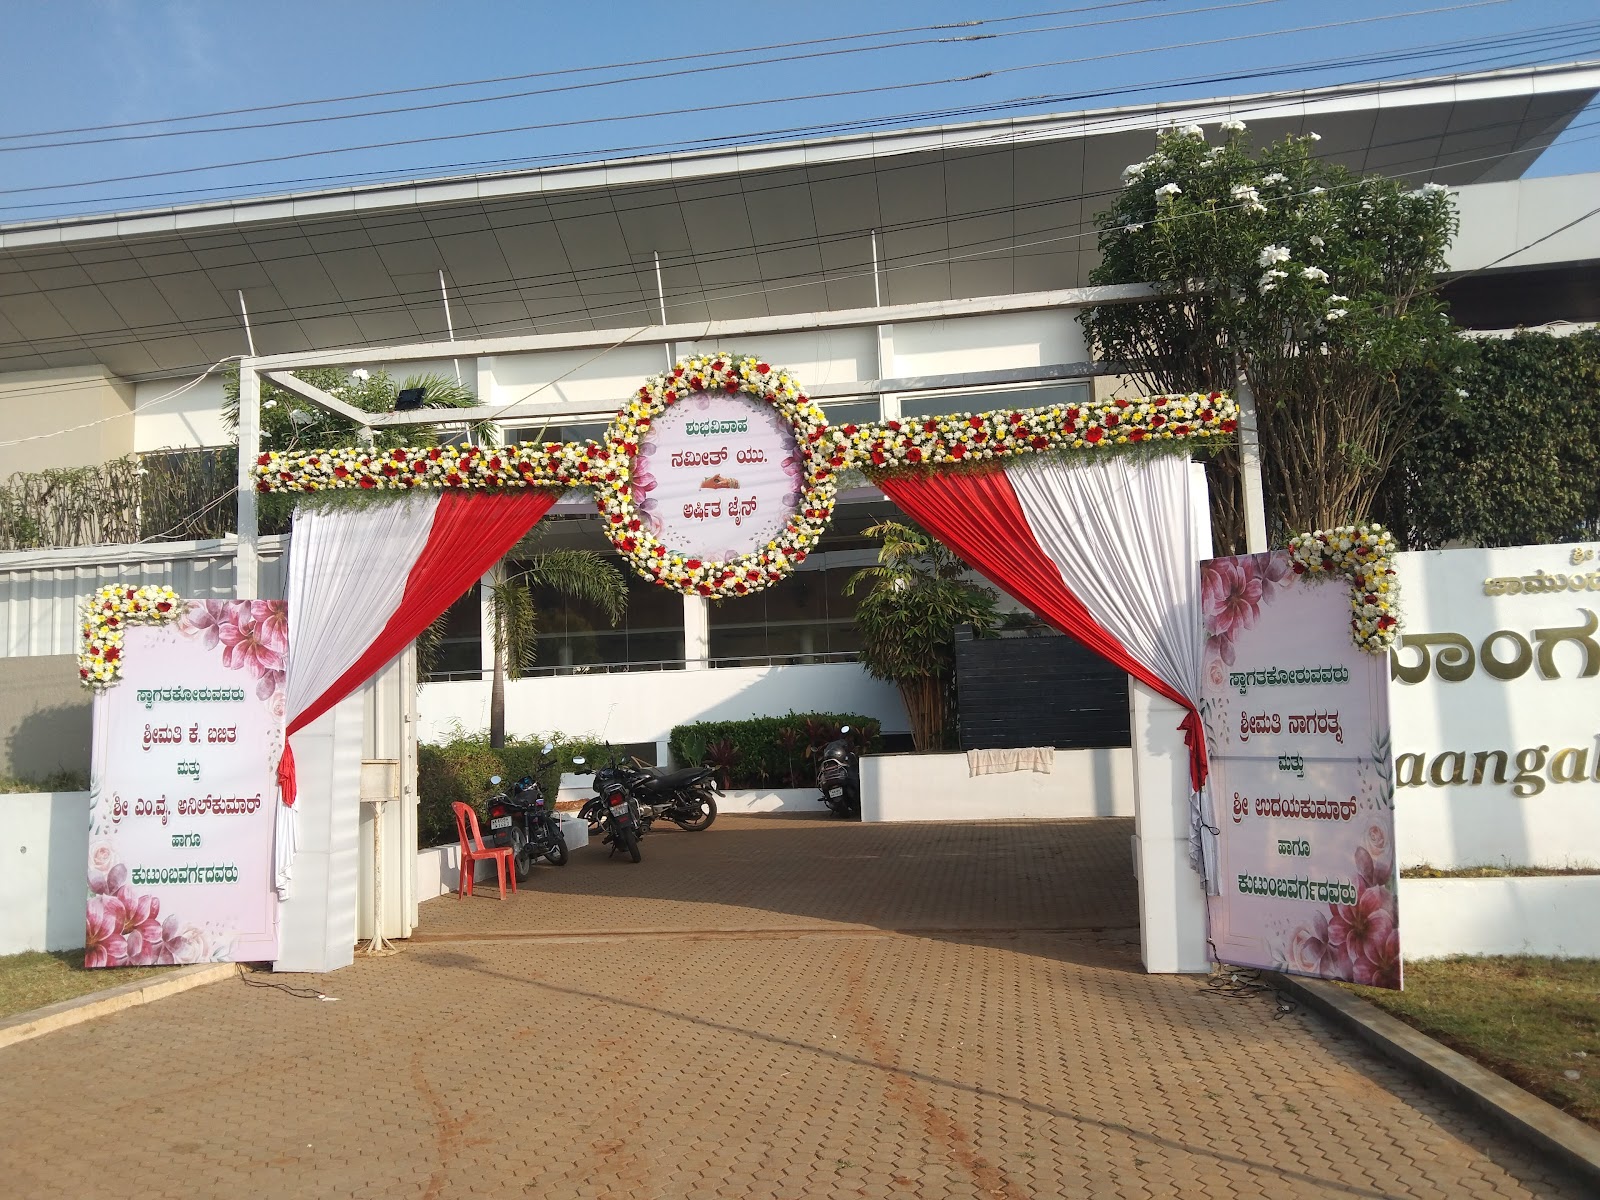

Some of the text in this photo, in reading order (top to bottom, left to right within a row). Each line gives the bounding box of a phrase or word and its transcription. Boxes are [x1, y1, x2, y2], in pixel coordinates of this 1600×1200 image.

[685, 416, 749, 437] ಶುಭವಿವಾಹ
[671, 446, 728, 468] ನಮೀತ್
[728, 495, 758, 526] ಜೈನ್
[142, 723, 182, 751] ಶ್ರೀಮತಿ
[1240, 709, 1282, 743] ಶ್ರೀಮತಿ
[176, 758, 200, 780] ಮತ್ತು
[1278, 752, 1304, 778] ಮತ್ತು
[112, 796, 129, 824] ಶ್ರೀ
[1232, 791, 1357, 824] ಶ್ರೀ ಉದಯಕುಮಾರ್
[171, 830, 202, 848] ಹಾಗೂ
[1278, 836, 1311, 857] ಹಾಗೂ
